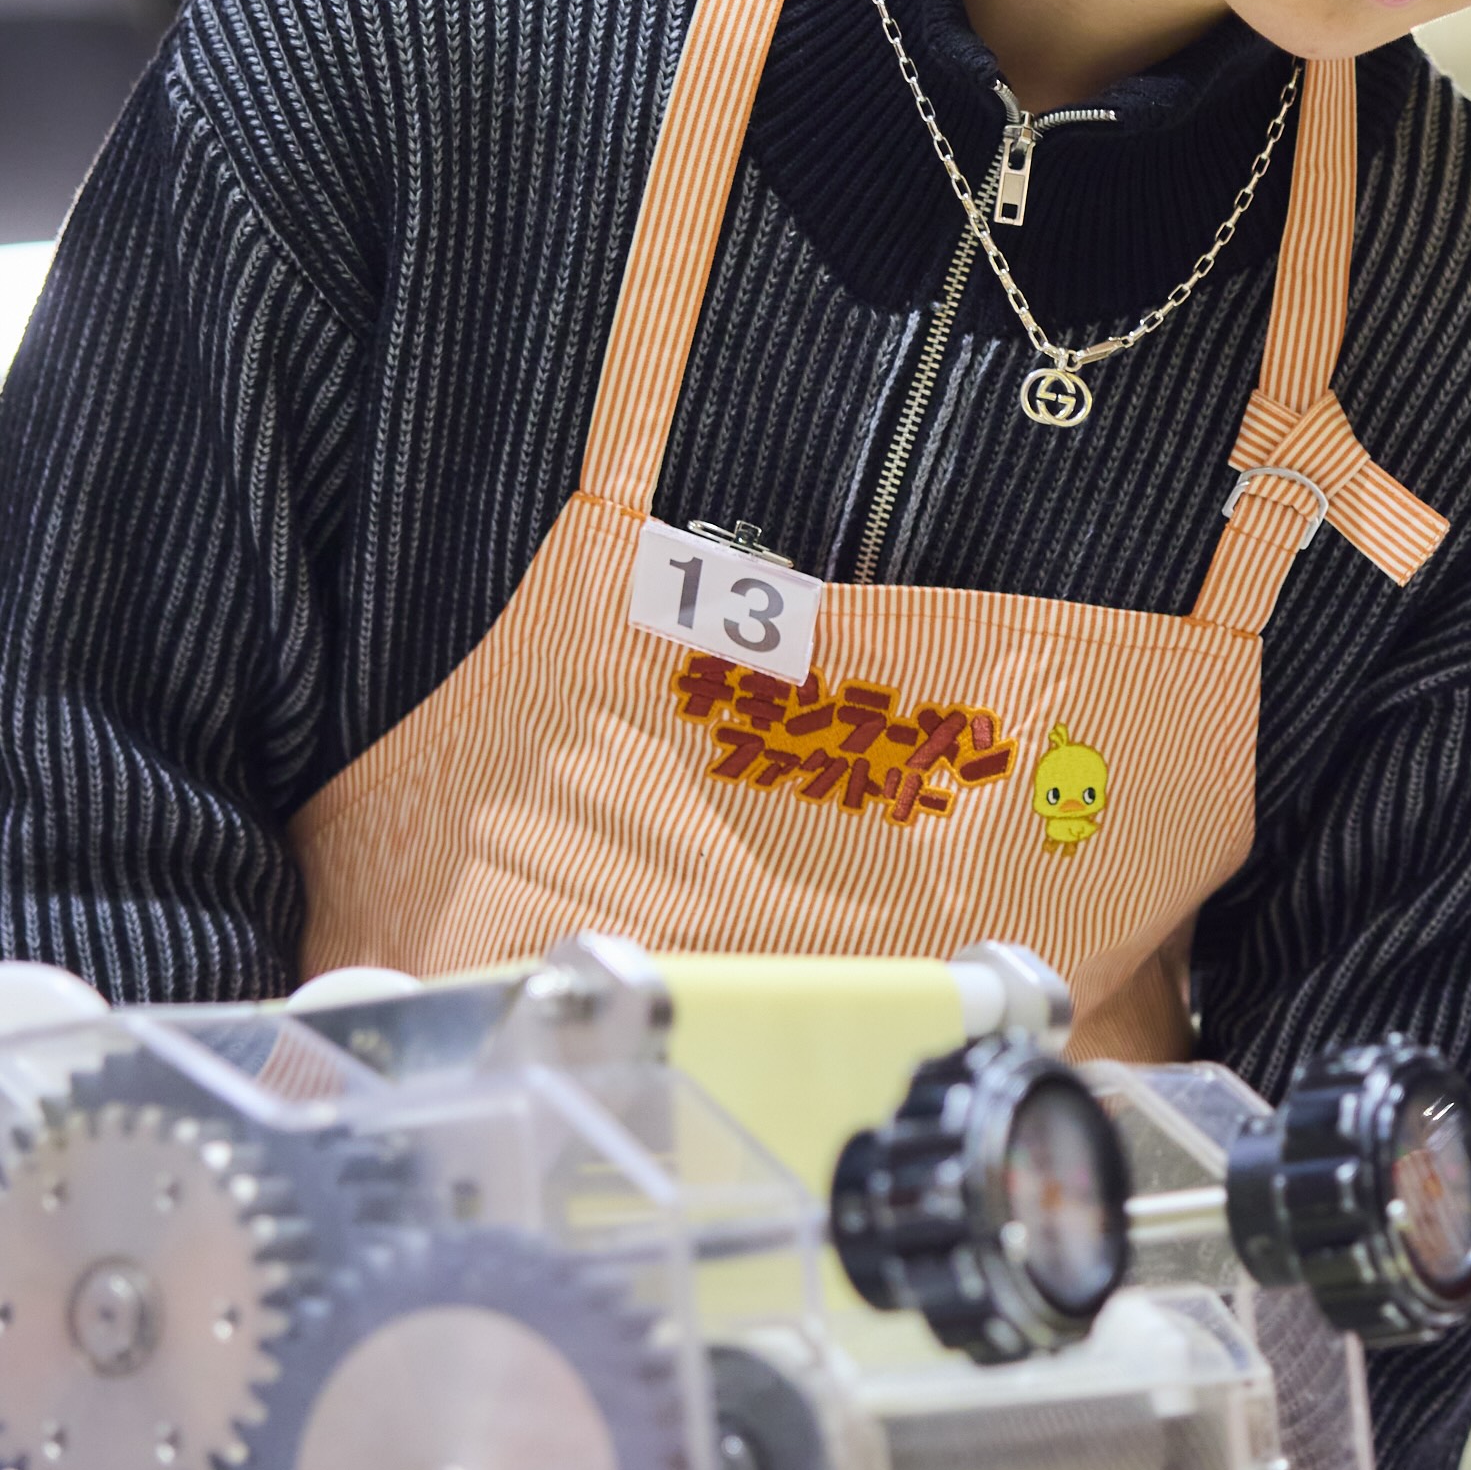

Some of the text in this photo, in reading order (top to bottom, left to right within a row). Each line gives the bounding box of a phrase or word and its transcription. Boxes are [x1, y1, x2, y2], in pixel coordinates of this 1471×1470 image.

[668, 555, 786, 653] 13
[710, 726, 950, 823] ファクトリー
